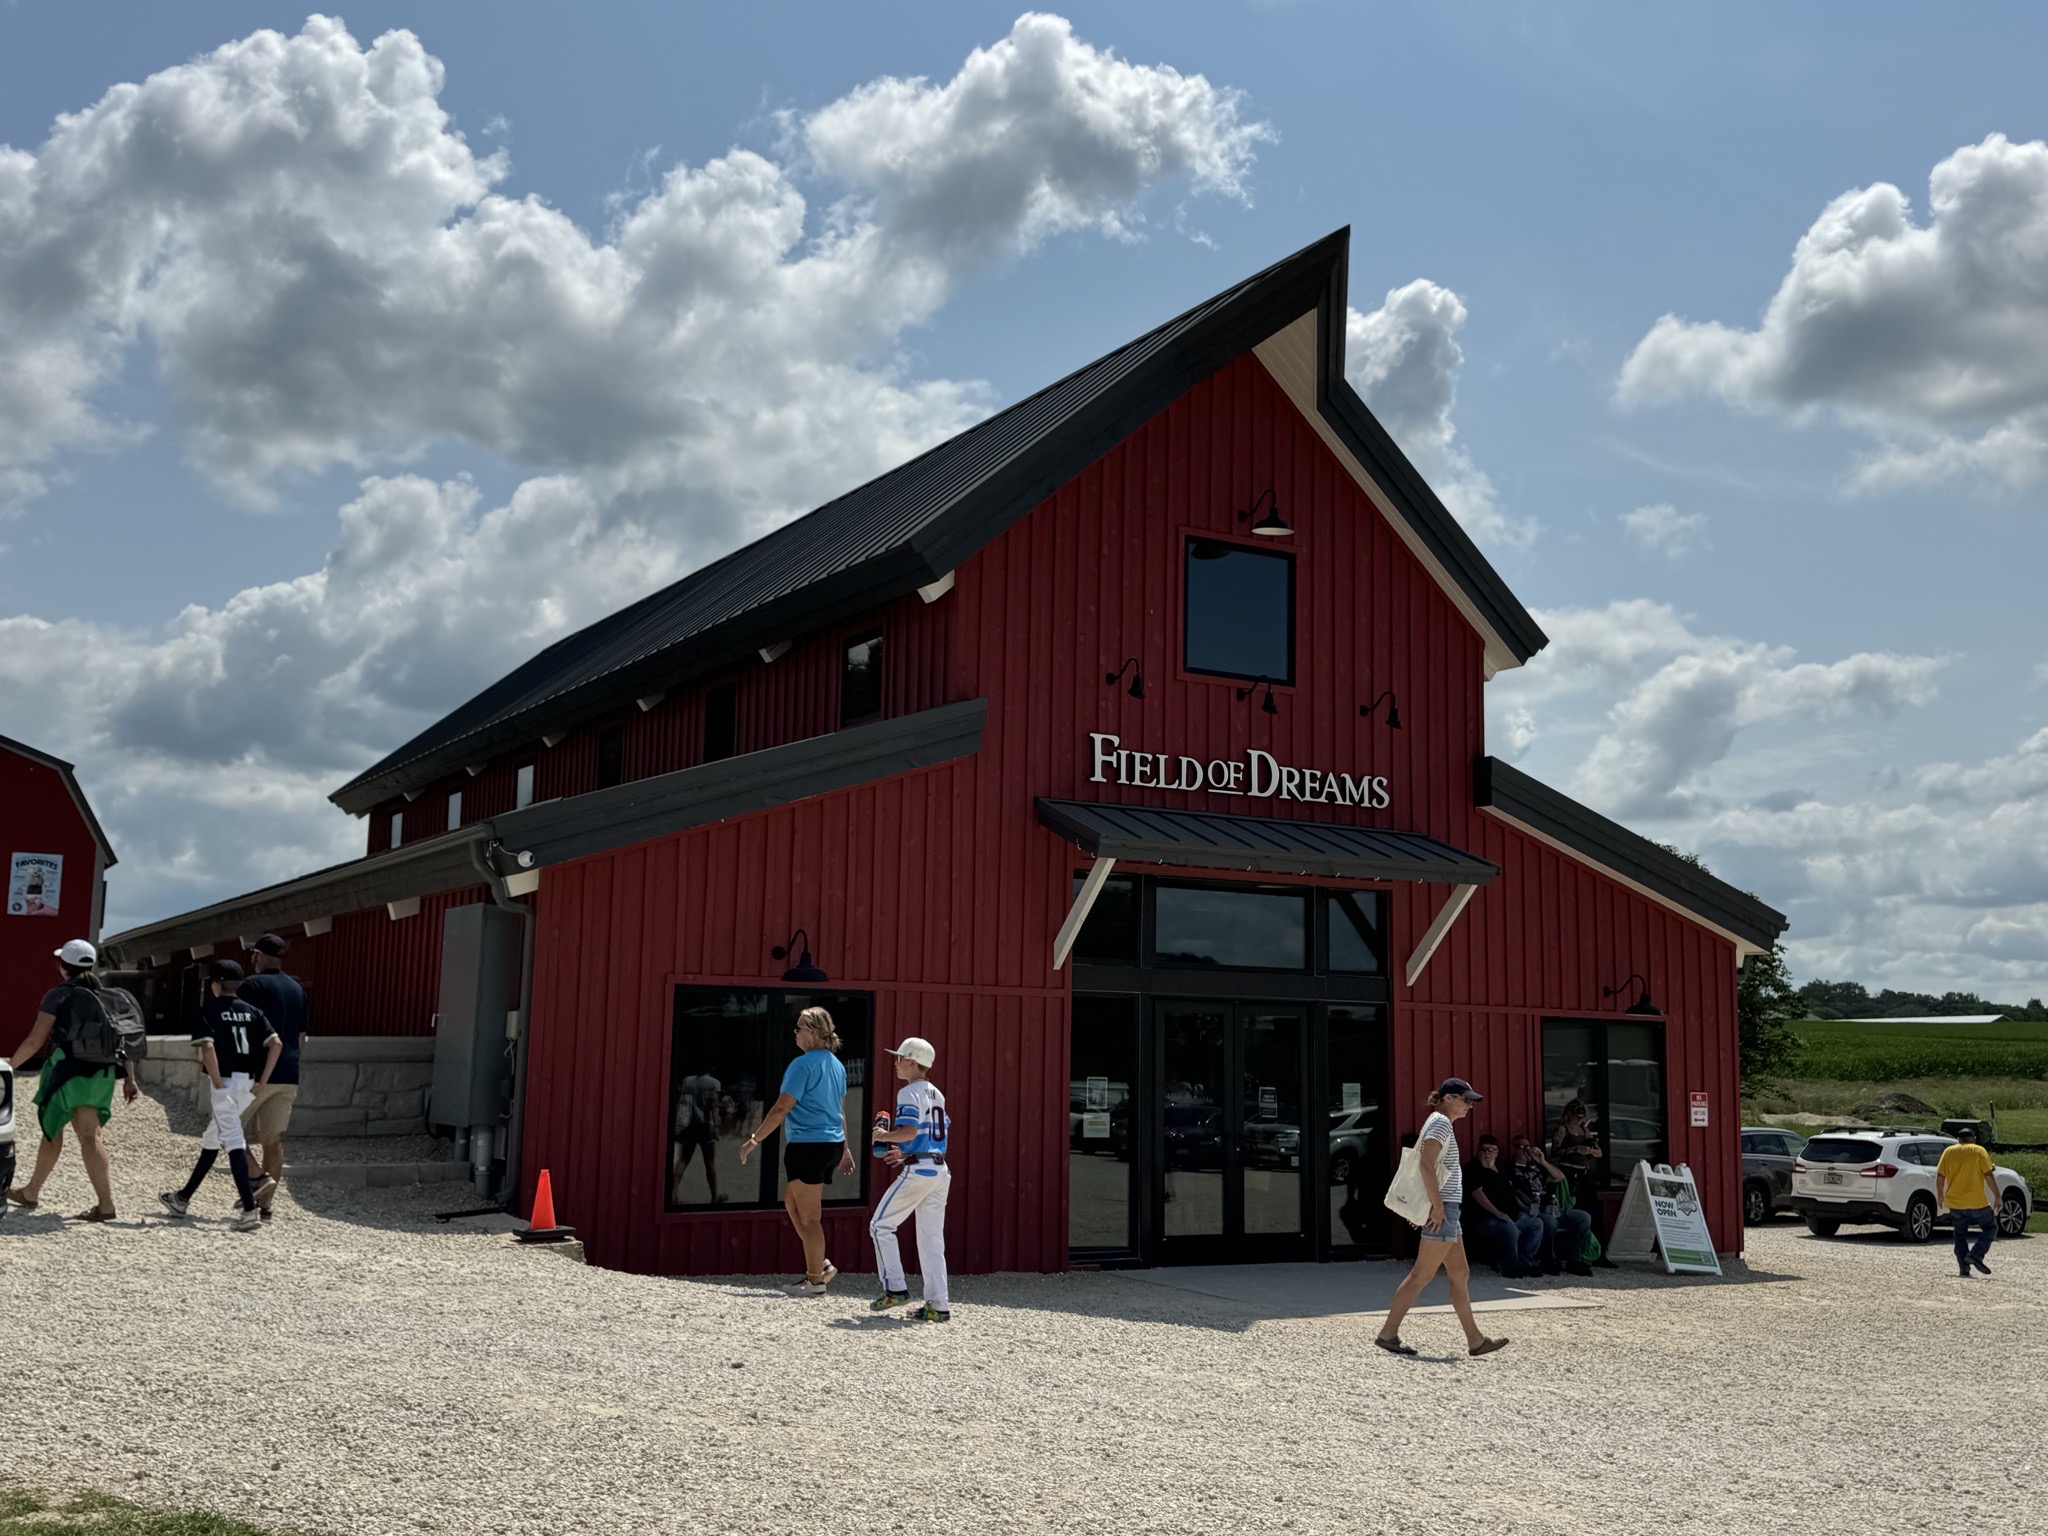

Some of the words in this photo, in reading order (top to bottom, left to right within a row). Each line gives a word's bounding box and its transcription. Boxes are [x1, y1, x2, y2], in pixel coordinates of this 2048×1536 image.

[1089, 732, 1204, 791] FIELD
[1207, 760, 1245, 795] OF
[1246, 748, 1390, 809] DREAMS
[15, 859, 58, 870] FAVORITES
[221, 1011, 251, 1022] CLARK
[231, 1025, 249, 1054] 11
[925, 1106, 945, 1142] 10
[1655, 1199, 1674, 1209] NOW
[1657, 1208, 1677, 1217] OPEN
